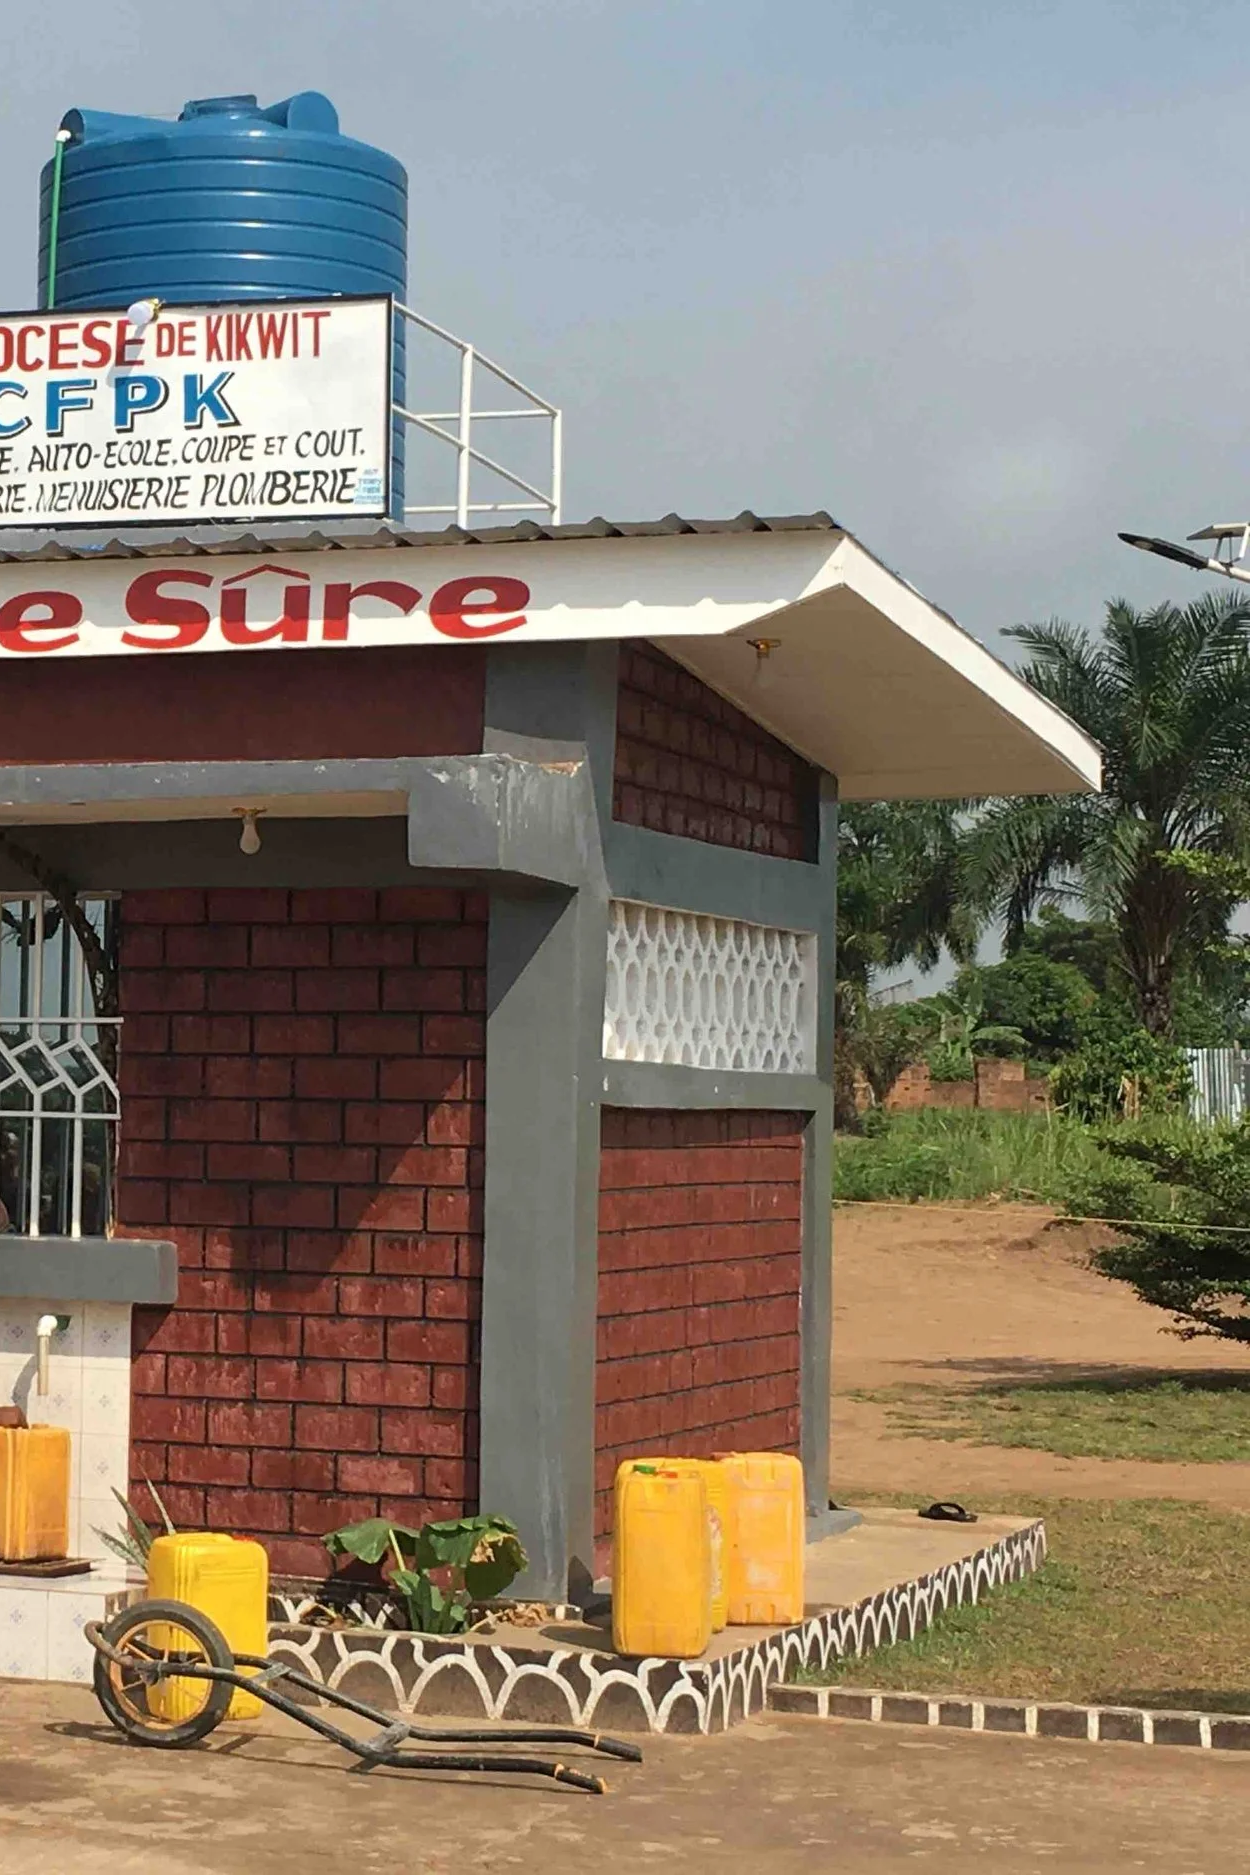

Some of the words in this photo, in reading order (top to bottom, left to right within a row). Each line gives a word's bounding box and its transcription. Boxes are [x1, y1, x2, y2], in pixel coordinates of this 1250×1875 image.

[156, 321, 196, 357] DE
[206, 311, 331, 362] KIKWIT
[264, 435, 287, 456] ET
[200, 467, 357, 507] PLOMBERIE
[121, 563, 531, 650] Sûre
